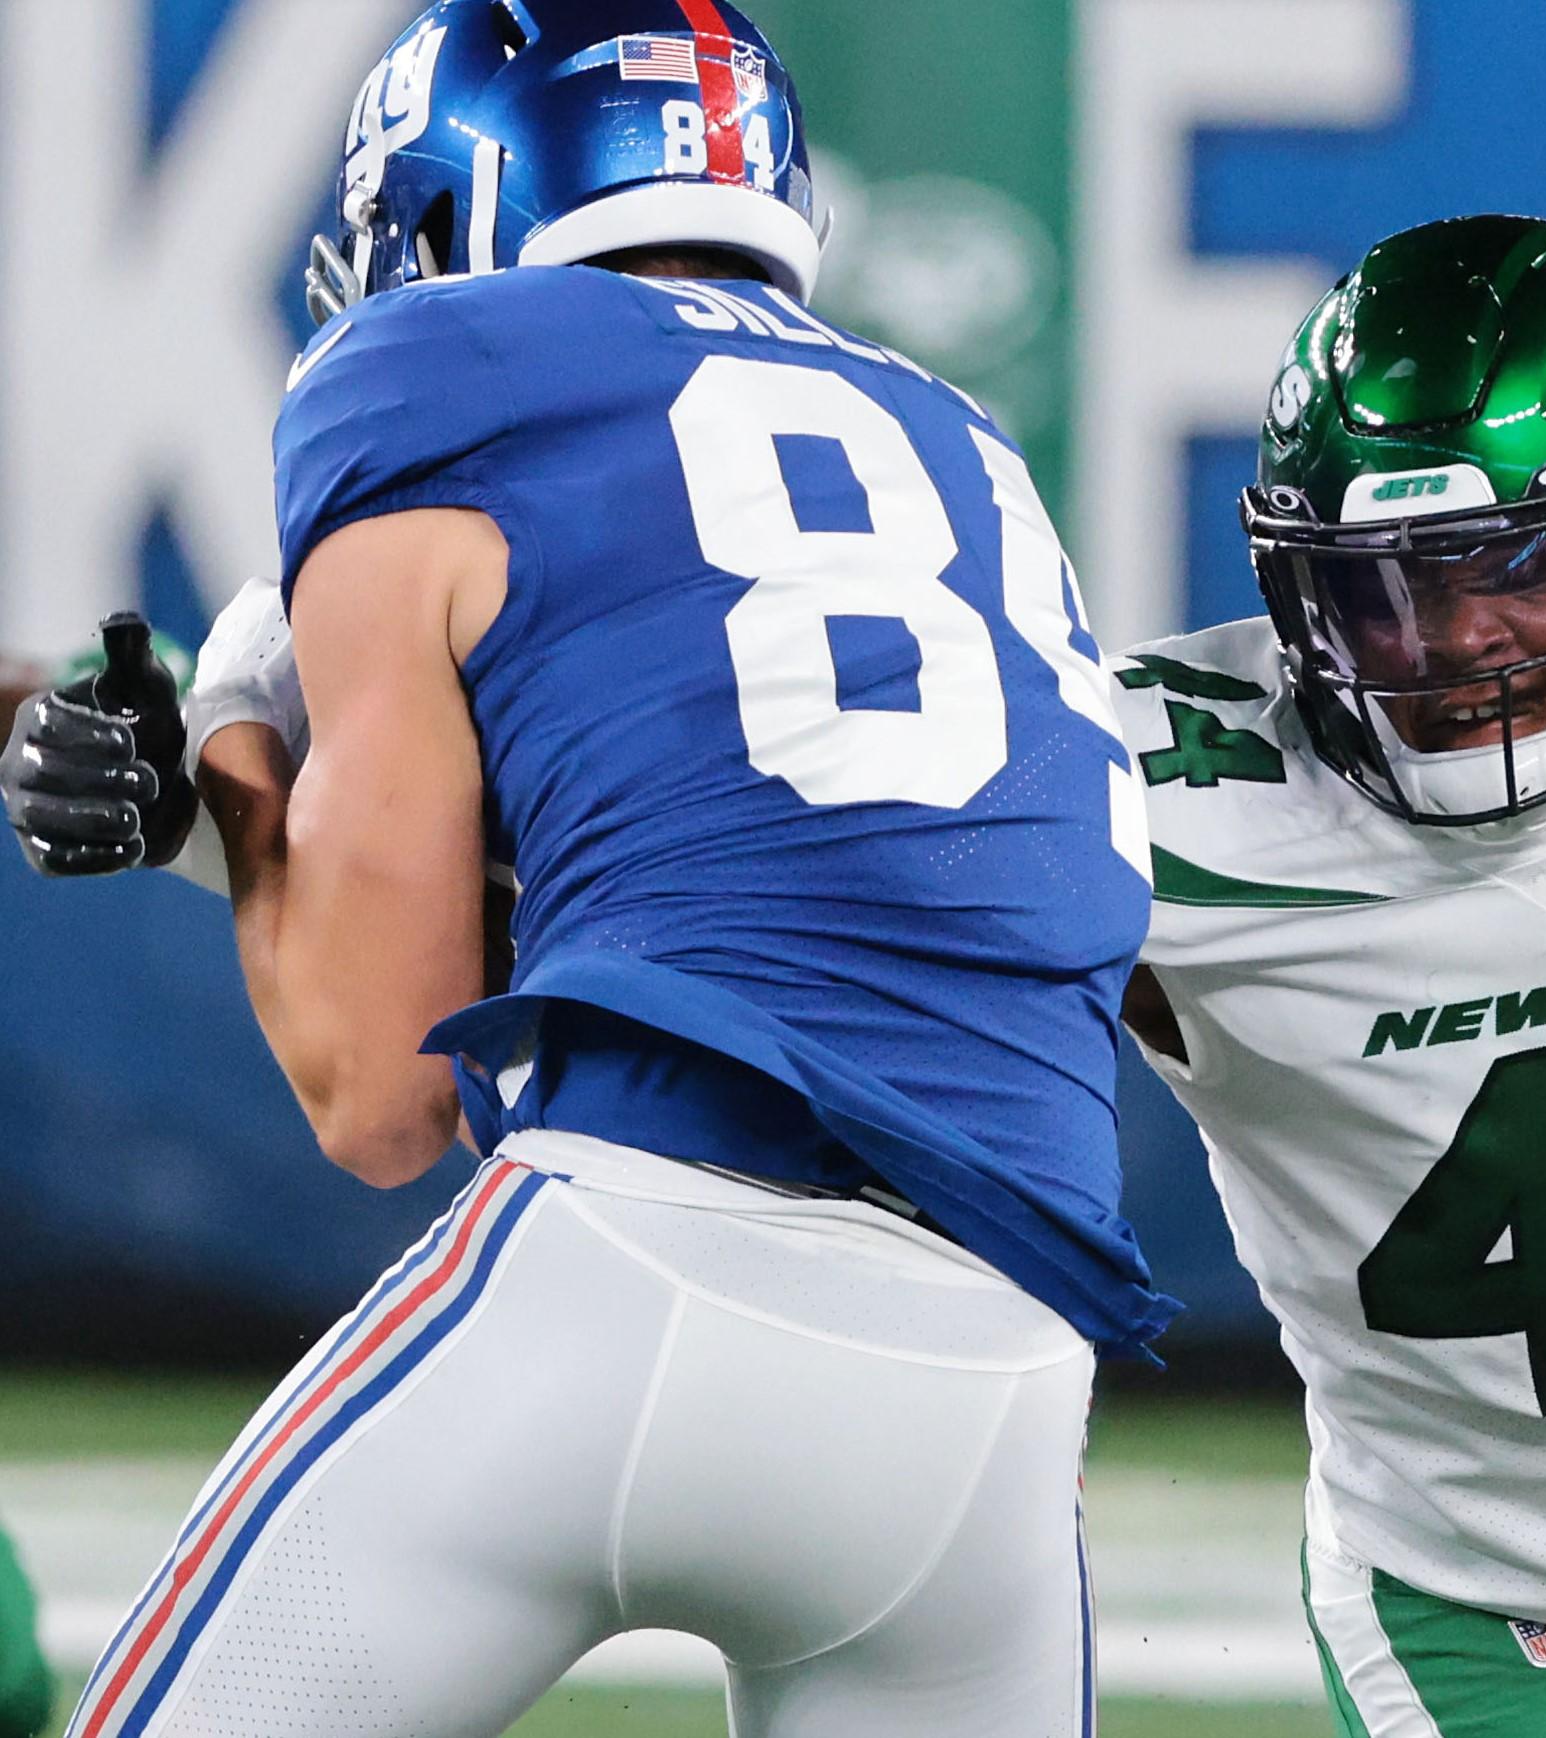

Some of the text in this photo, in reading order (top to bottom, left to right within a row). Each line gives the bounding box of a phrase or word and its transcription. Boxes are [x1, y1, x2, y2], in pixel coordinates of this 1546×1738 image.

[661, 99, 776, 191] 84
[638, 276, 933, 383] SILL
[1371, 474, 1450, 502] JETS
